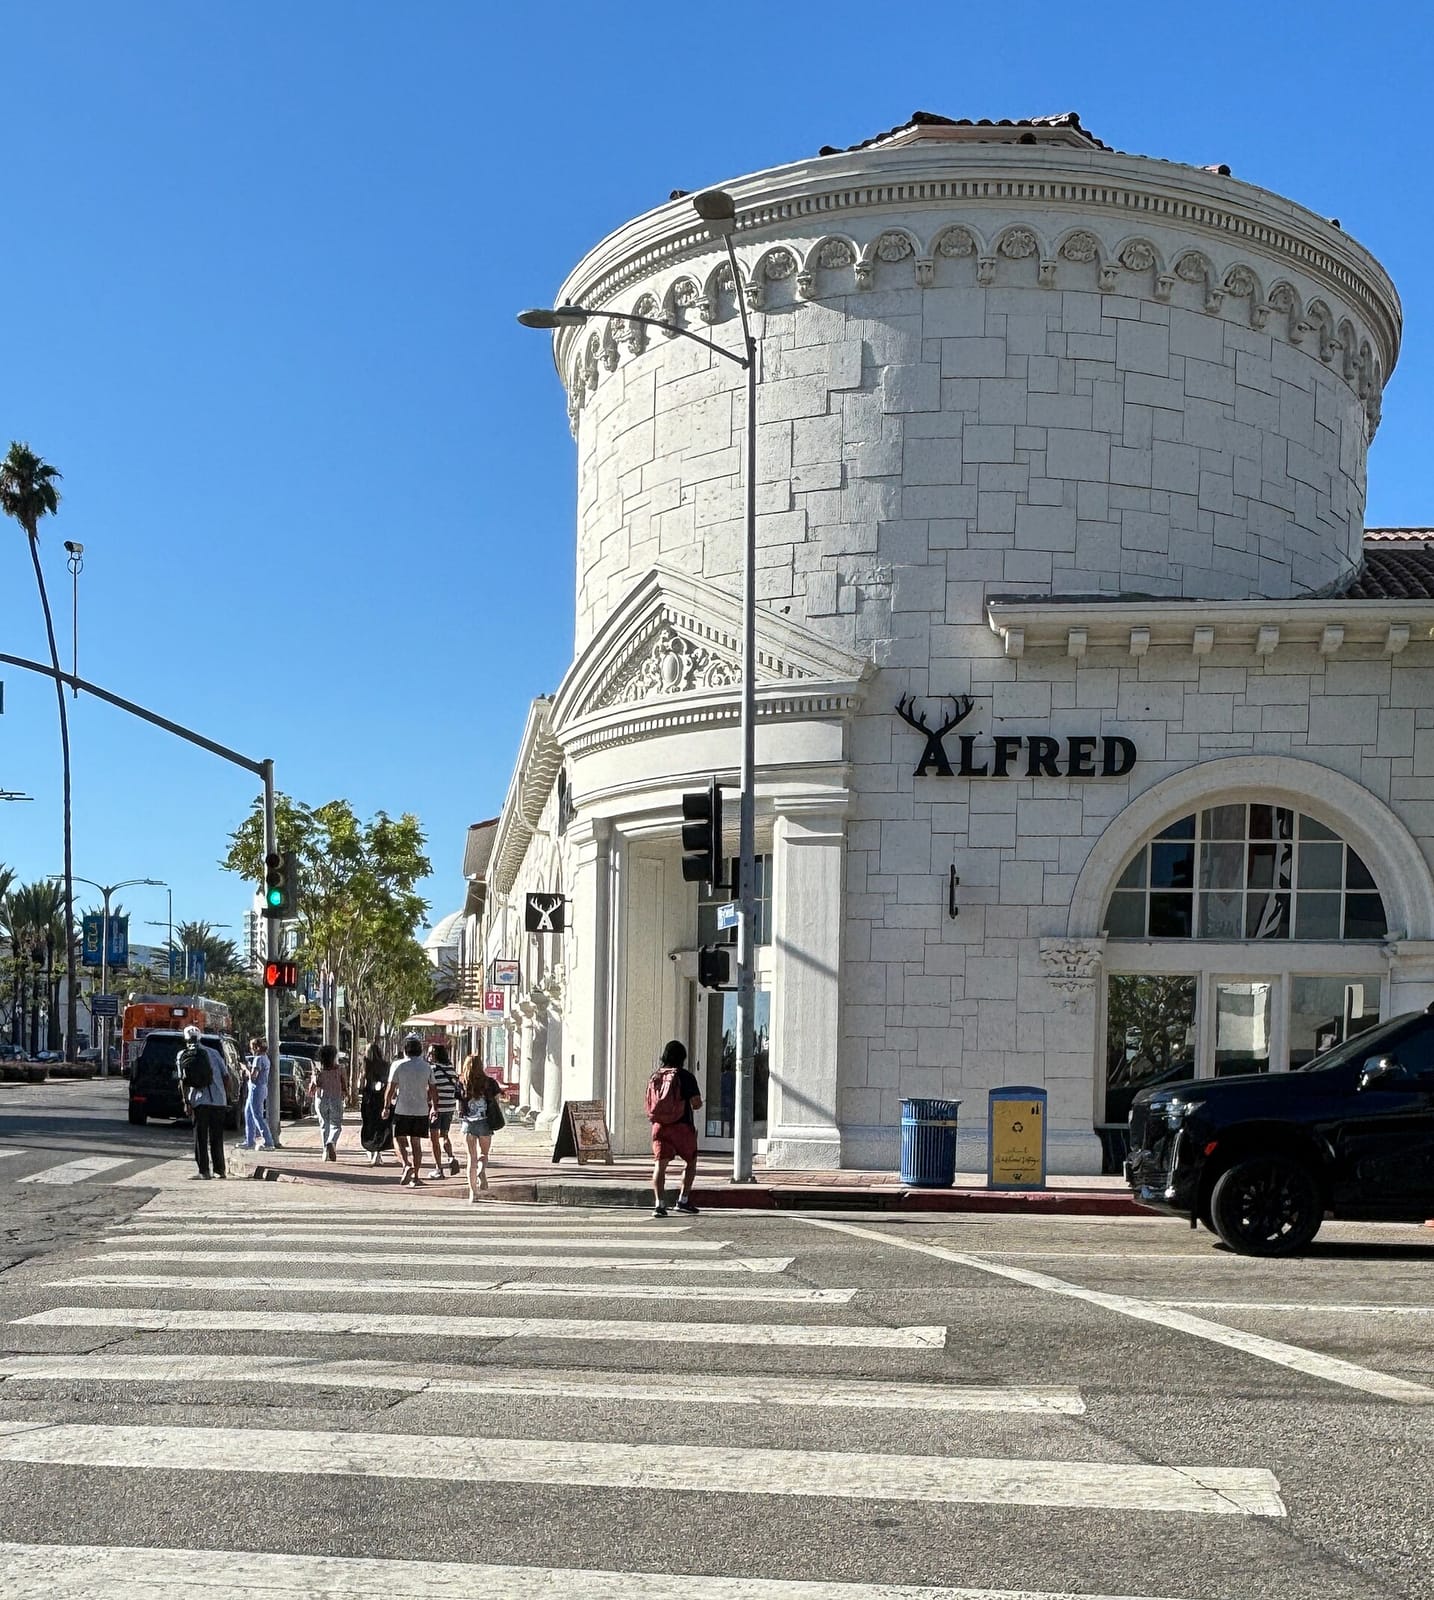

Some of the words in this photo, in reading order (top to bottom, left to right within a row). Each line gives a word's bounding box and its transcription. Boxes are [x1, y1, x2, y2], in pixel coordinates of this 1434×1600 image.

[912, 728, 1138, 777] ALFRED
[284, 965, 295, 985] 11
[488, 993, 501, 1009] T
